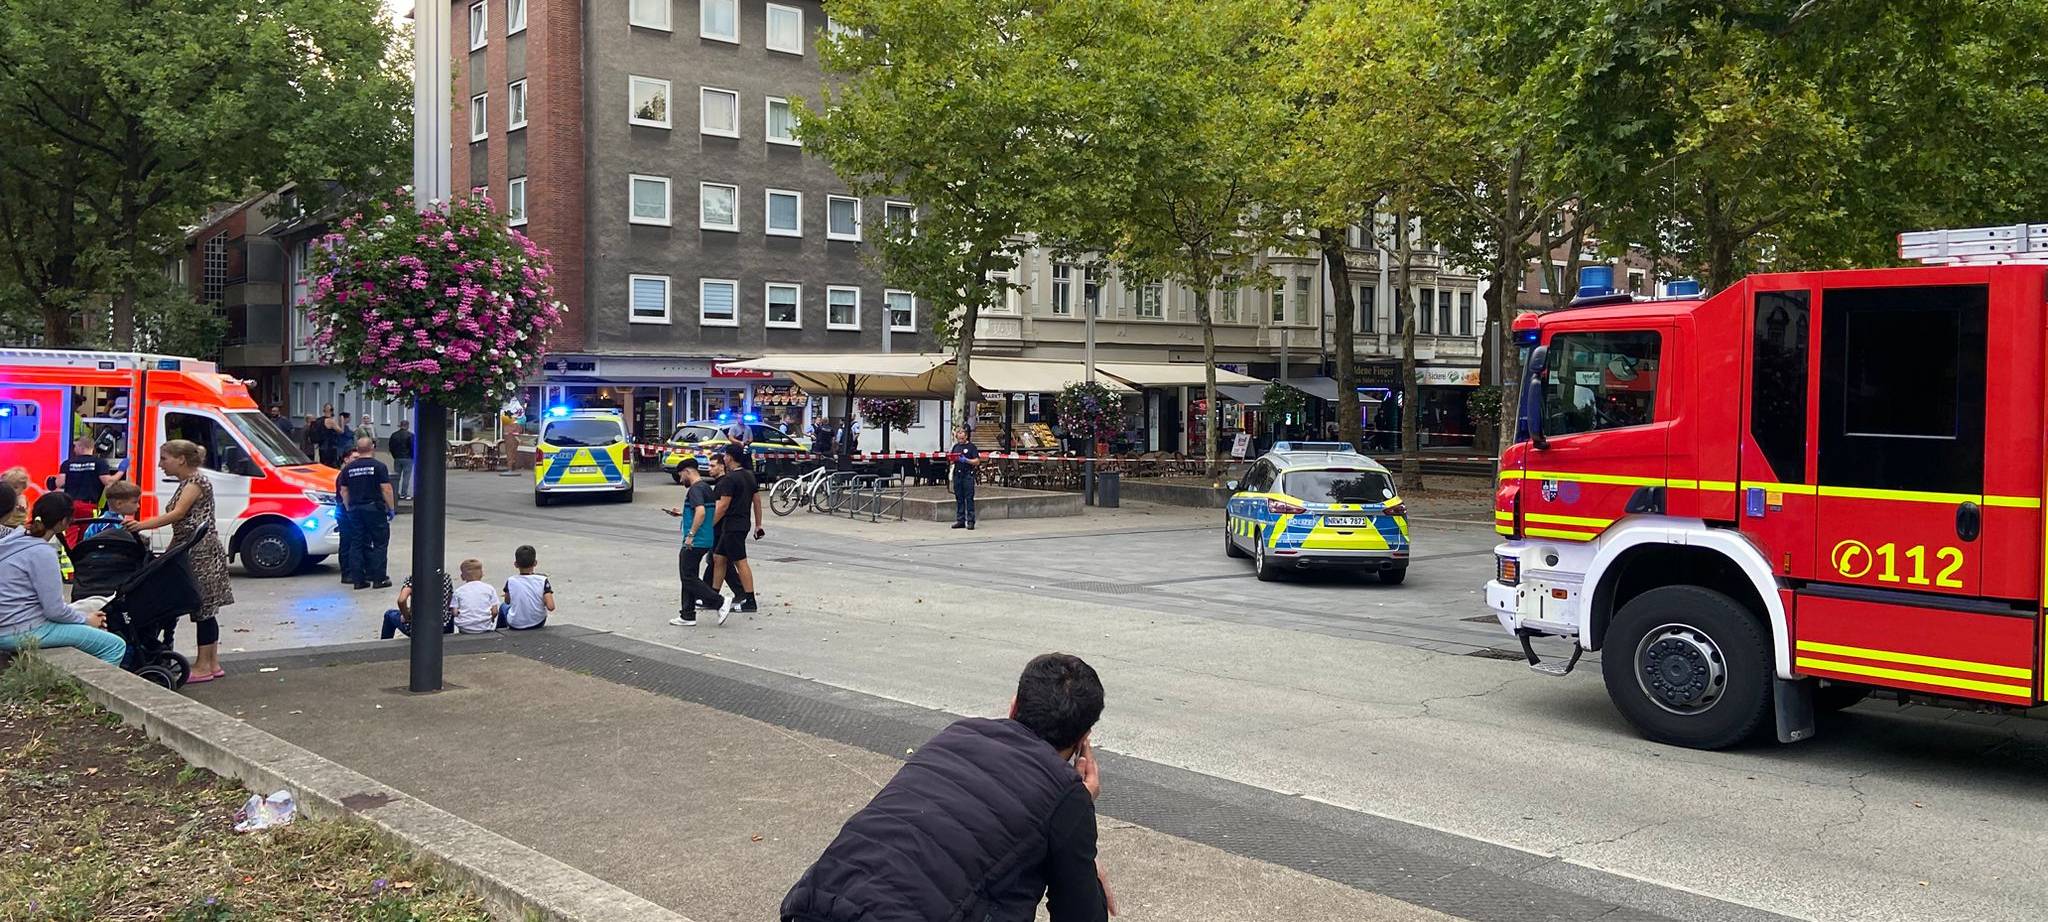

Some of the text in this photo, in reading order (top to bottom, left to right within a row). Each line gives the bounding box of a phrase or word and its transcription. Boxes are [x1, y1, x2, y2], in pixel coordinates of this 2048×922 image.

[1373, 366, 1394, 378] Finger
[1350, 517, 1366, 525] 7871
[1876, 542, 1964, 589] 112
